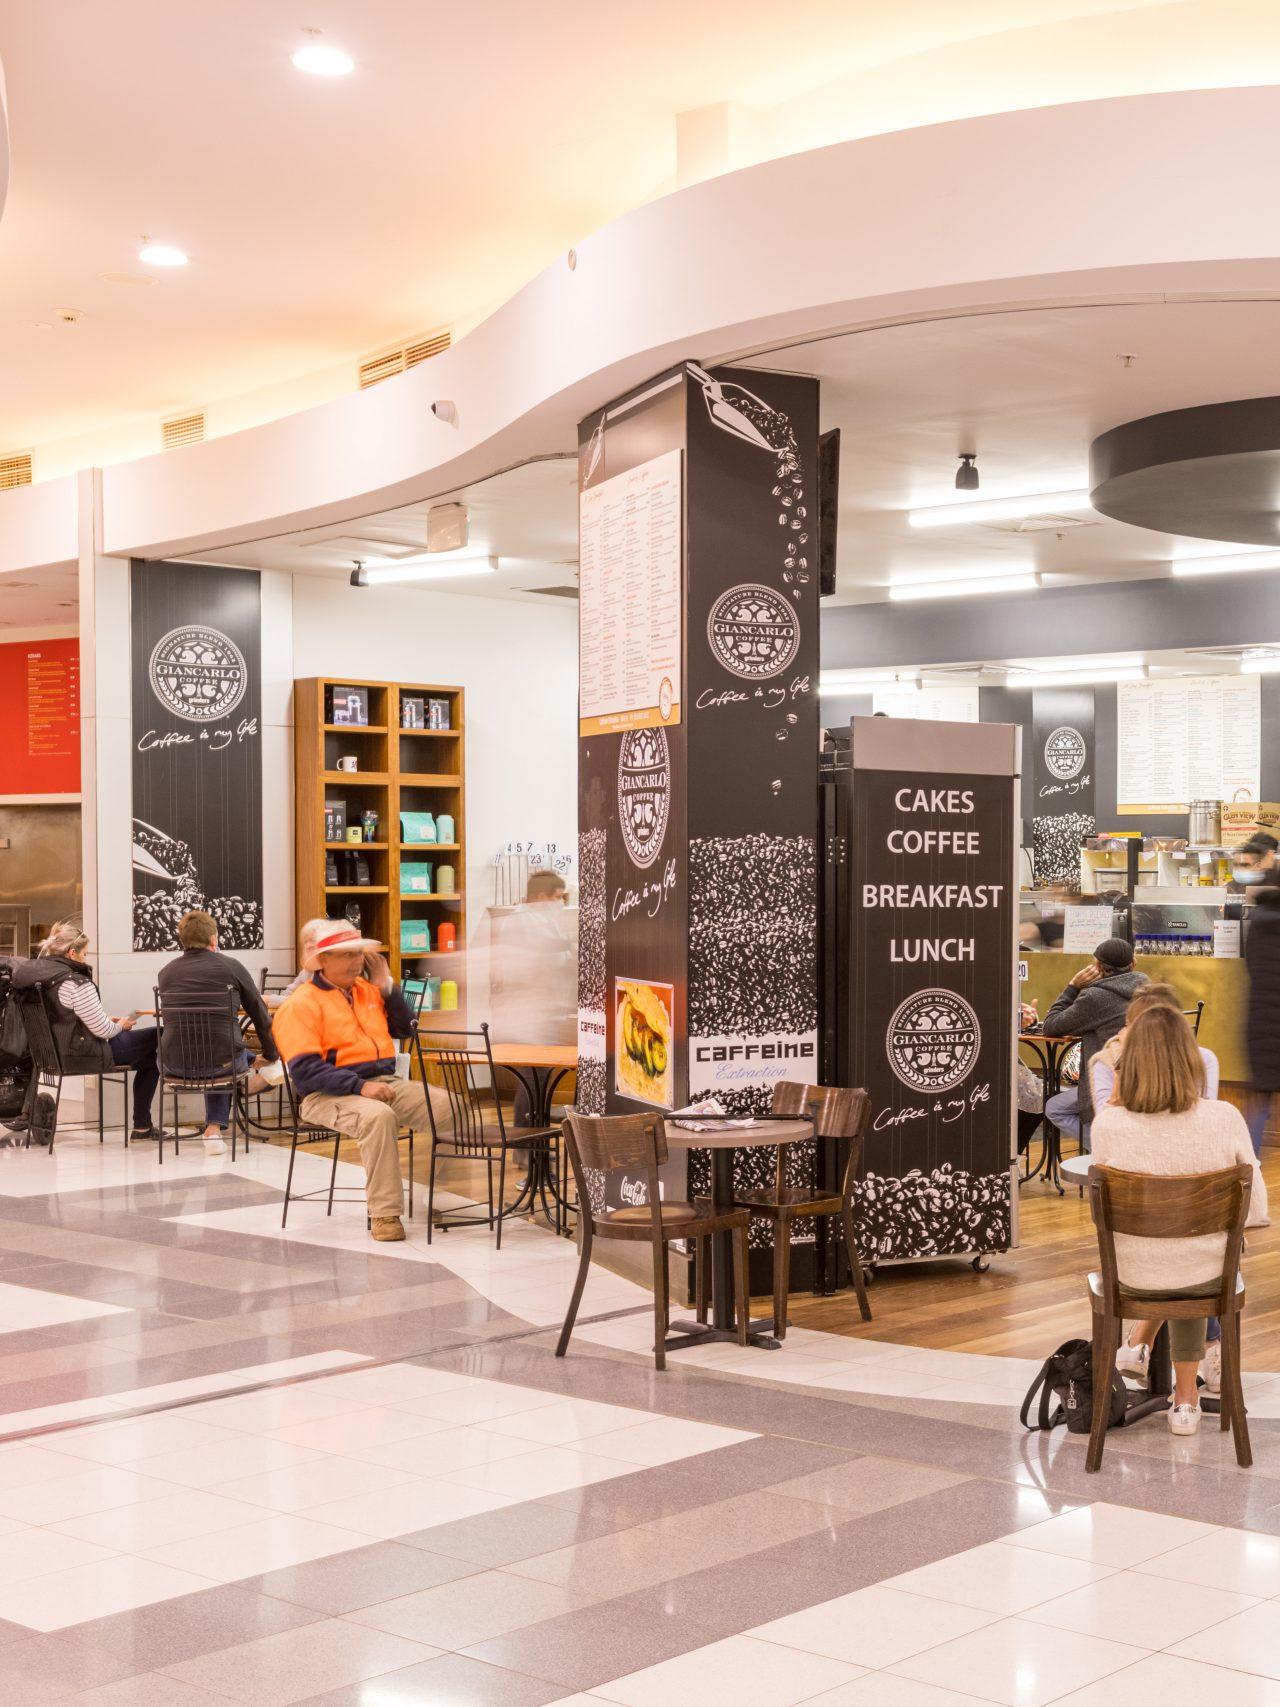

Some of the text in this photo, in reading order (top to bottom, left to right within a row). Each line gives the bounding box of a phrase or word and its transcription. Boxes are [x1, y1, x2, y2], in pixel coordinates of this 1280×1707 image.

[719, 591, 752, 617] SIGNATURE
[755, 592, 777, 604] BLEND
[714, 623, 794, 637] GIANCARLO
[735, 635, 773, 643] COFFEE
[161, 633, 196, 659] SIGNATURE
[198, 633, 223, 647] BLEND
[156, 664, 241, 679] GIANCARLO
[179, 677, 218, 685] COFFEE
[696, 676, 810, 709] Coffee is my life
[138, 718, 258, 751] Coffee is my life
[622, 772, 666, 790] GIANCARLO
[632, 793, 653, 802] COFFEE
[895, 788, 974, 813] CAKES
[516, 843, 522, 852] 5
[527, 843, 533, 852] 7
[547, 844, 556, 853] 13
[887, 830, 980, 854] COFFEE
[530, 854, 542, 864] 23
[554, 860, 566, 871] 22
[612, 858, 677, 921] Coffee is my life
[863, 884, 1003, 908] BREAKFAST
[890, 939, 975, 962] LUNCH
[897, 997, 933, 1027] SIGNATURE
[935, 997, 958, 1009] BLEND
[893, 1033, 974, 1046] GIANCARLO
[715, 1063, 787, 1081] Extraction
[873, 1083, 990, 1131] Coffee is my life
